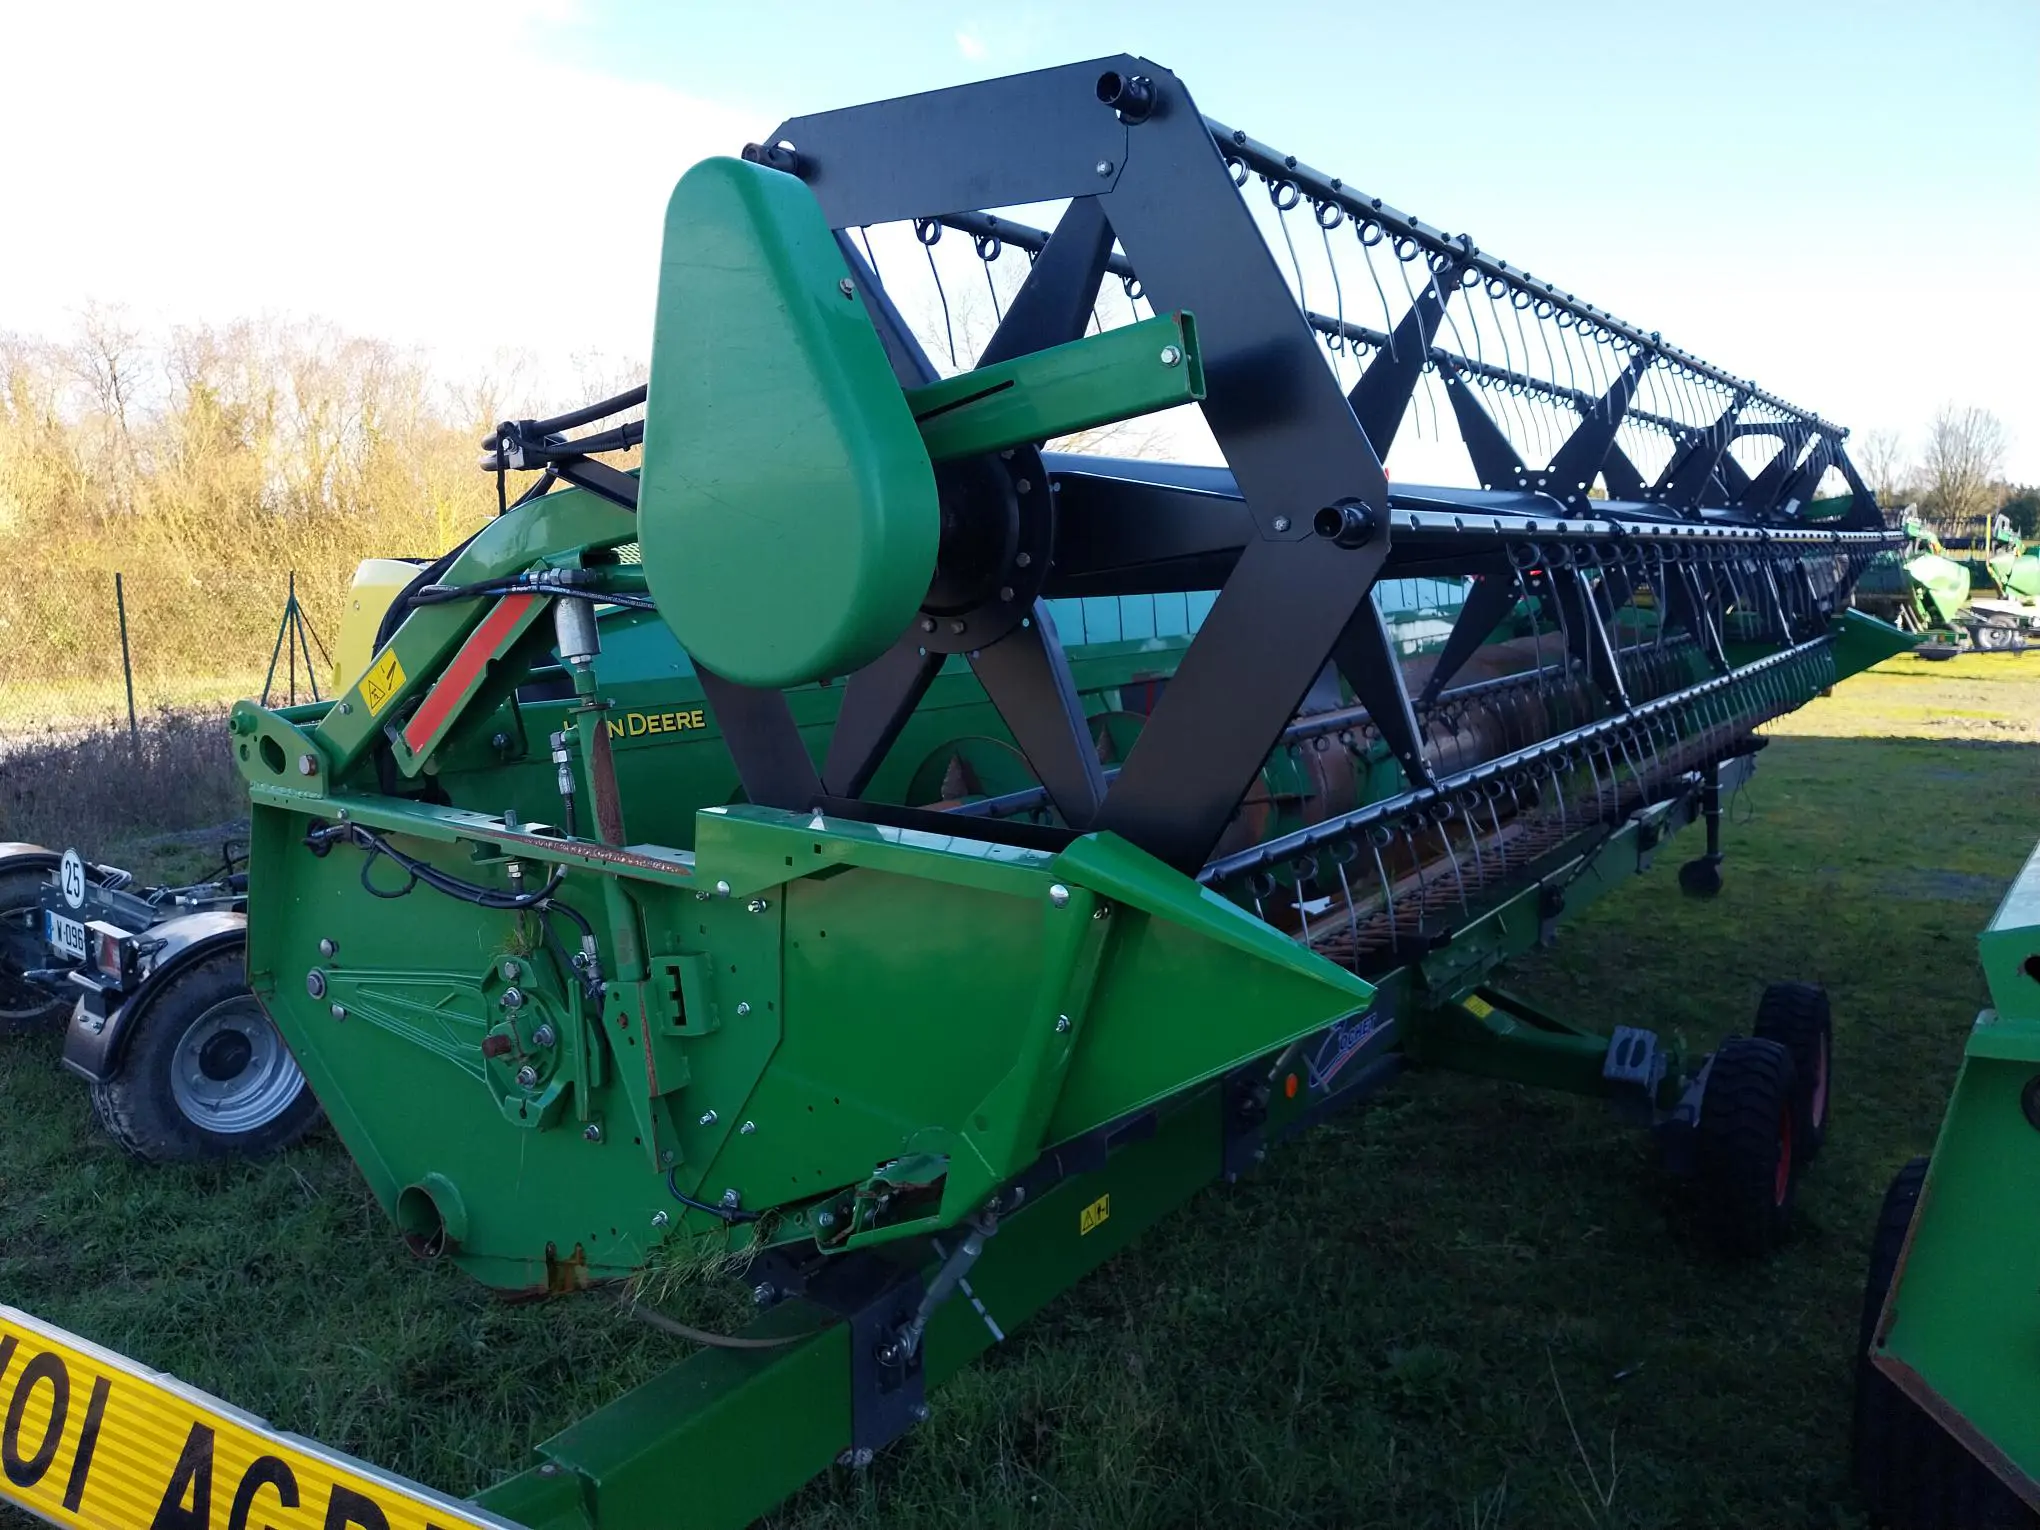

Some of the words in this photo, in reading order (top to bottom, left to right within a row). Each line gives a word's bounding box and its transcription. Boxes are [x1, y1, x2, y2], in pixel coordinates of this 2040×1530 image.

[627, 709, 706, 737] DEERE
[65, 859, 81, 899] 25
[0, 1334, 112, 1514] OI
